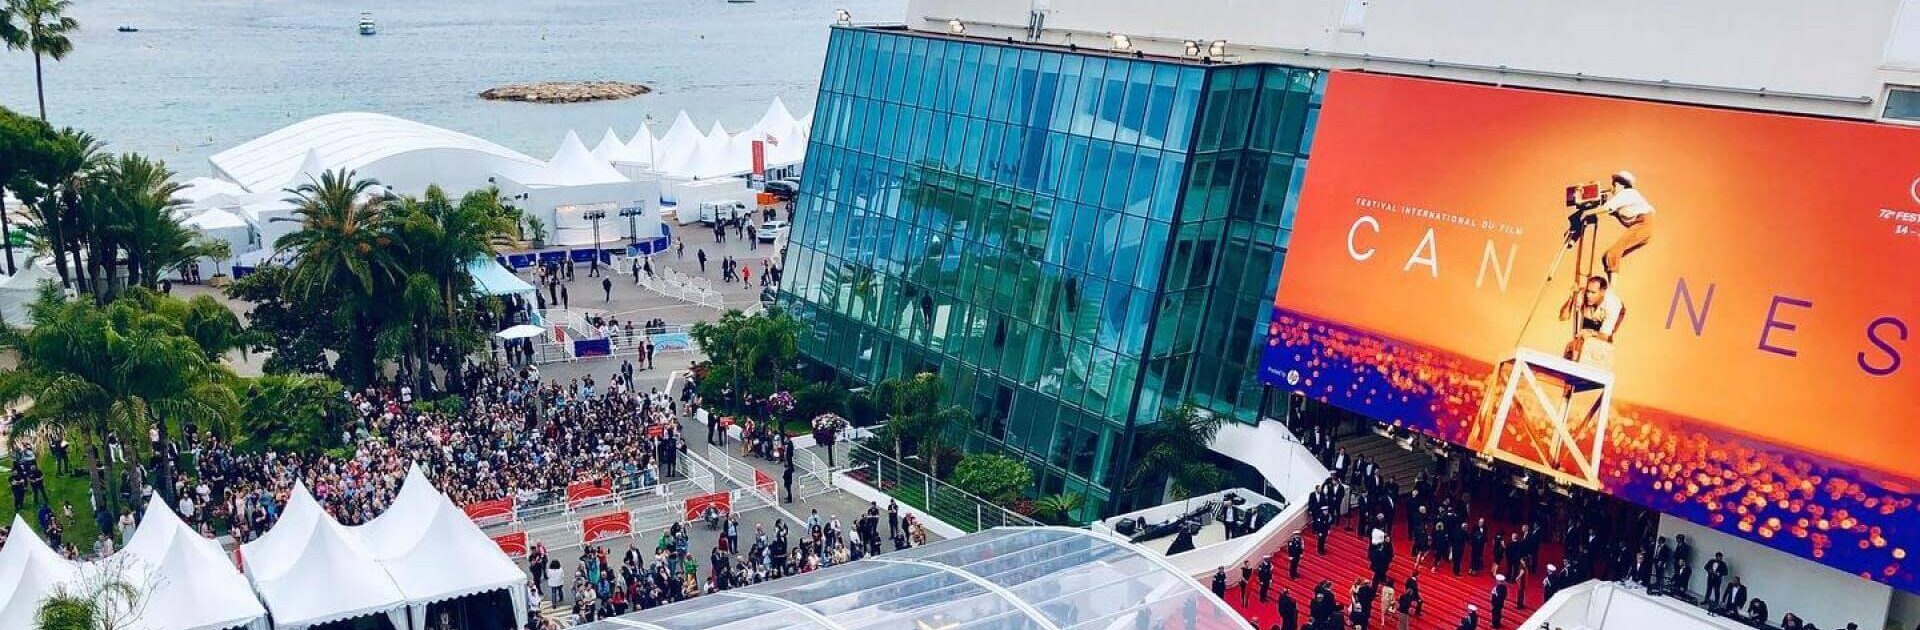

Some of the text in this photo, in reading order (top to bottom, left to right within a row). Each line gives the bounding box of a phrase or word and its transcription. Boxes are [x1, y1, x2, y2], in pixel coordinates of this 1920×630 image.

[1355, 198, 1523, 235] FESTIVAL INTERNATIONAL DU FILM
